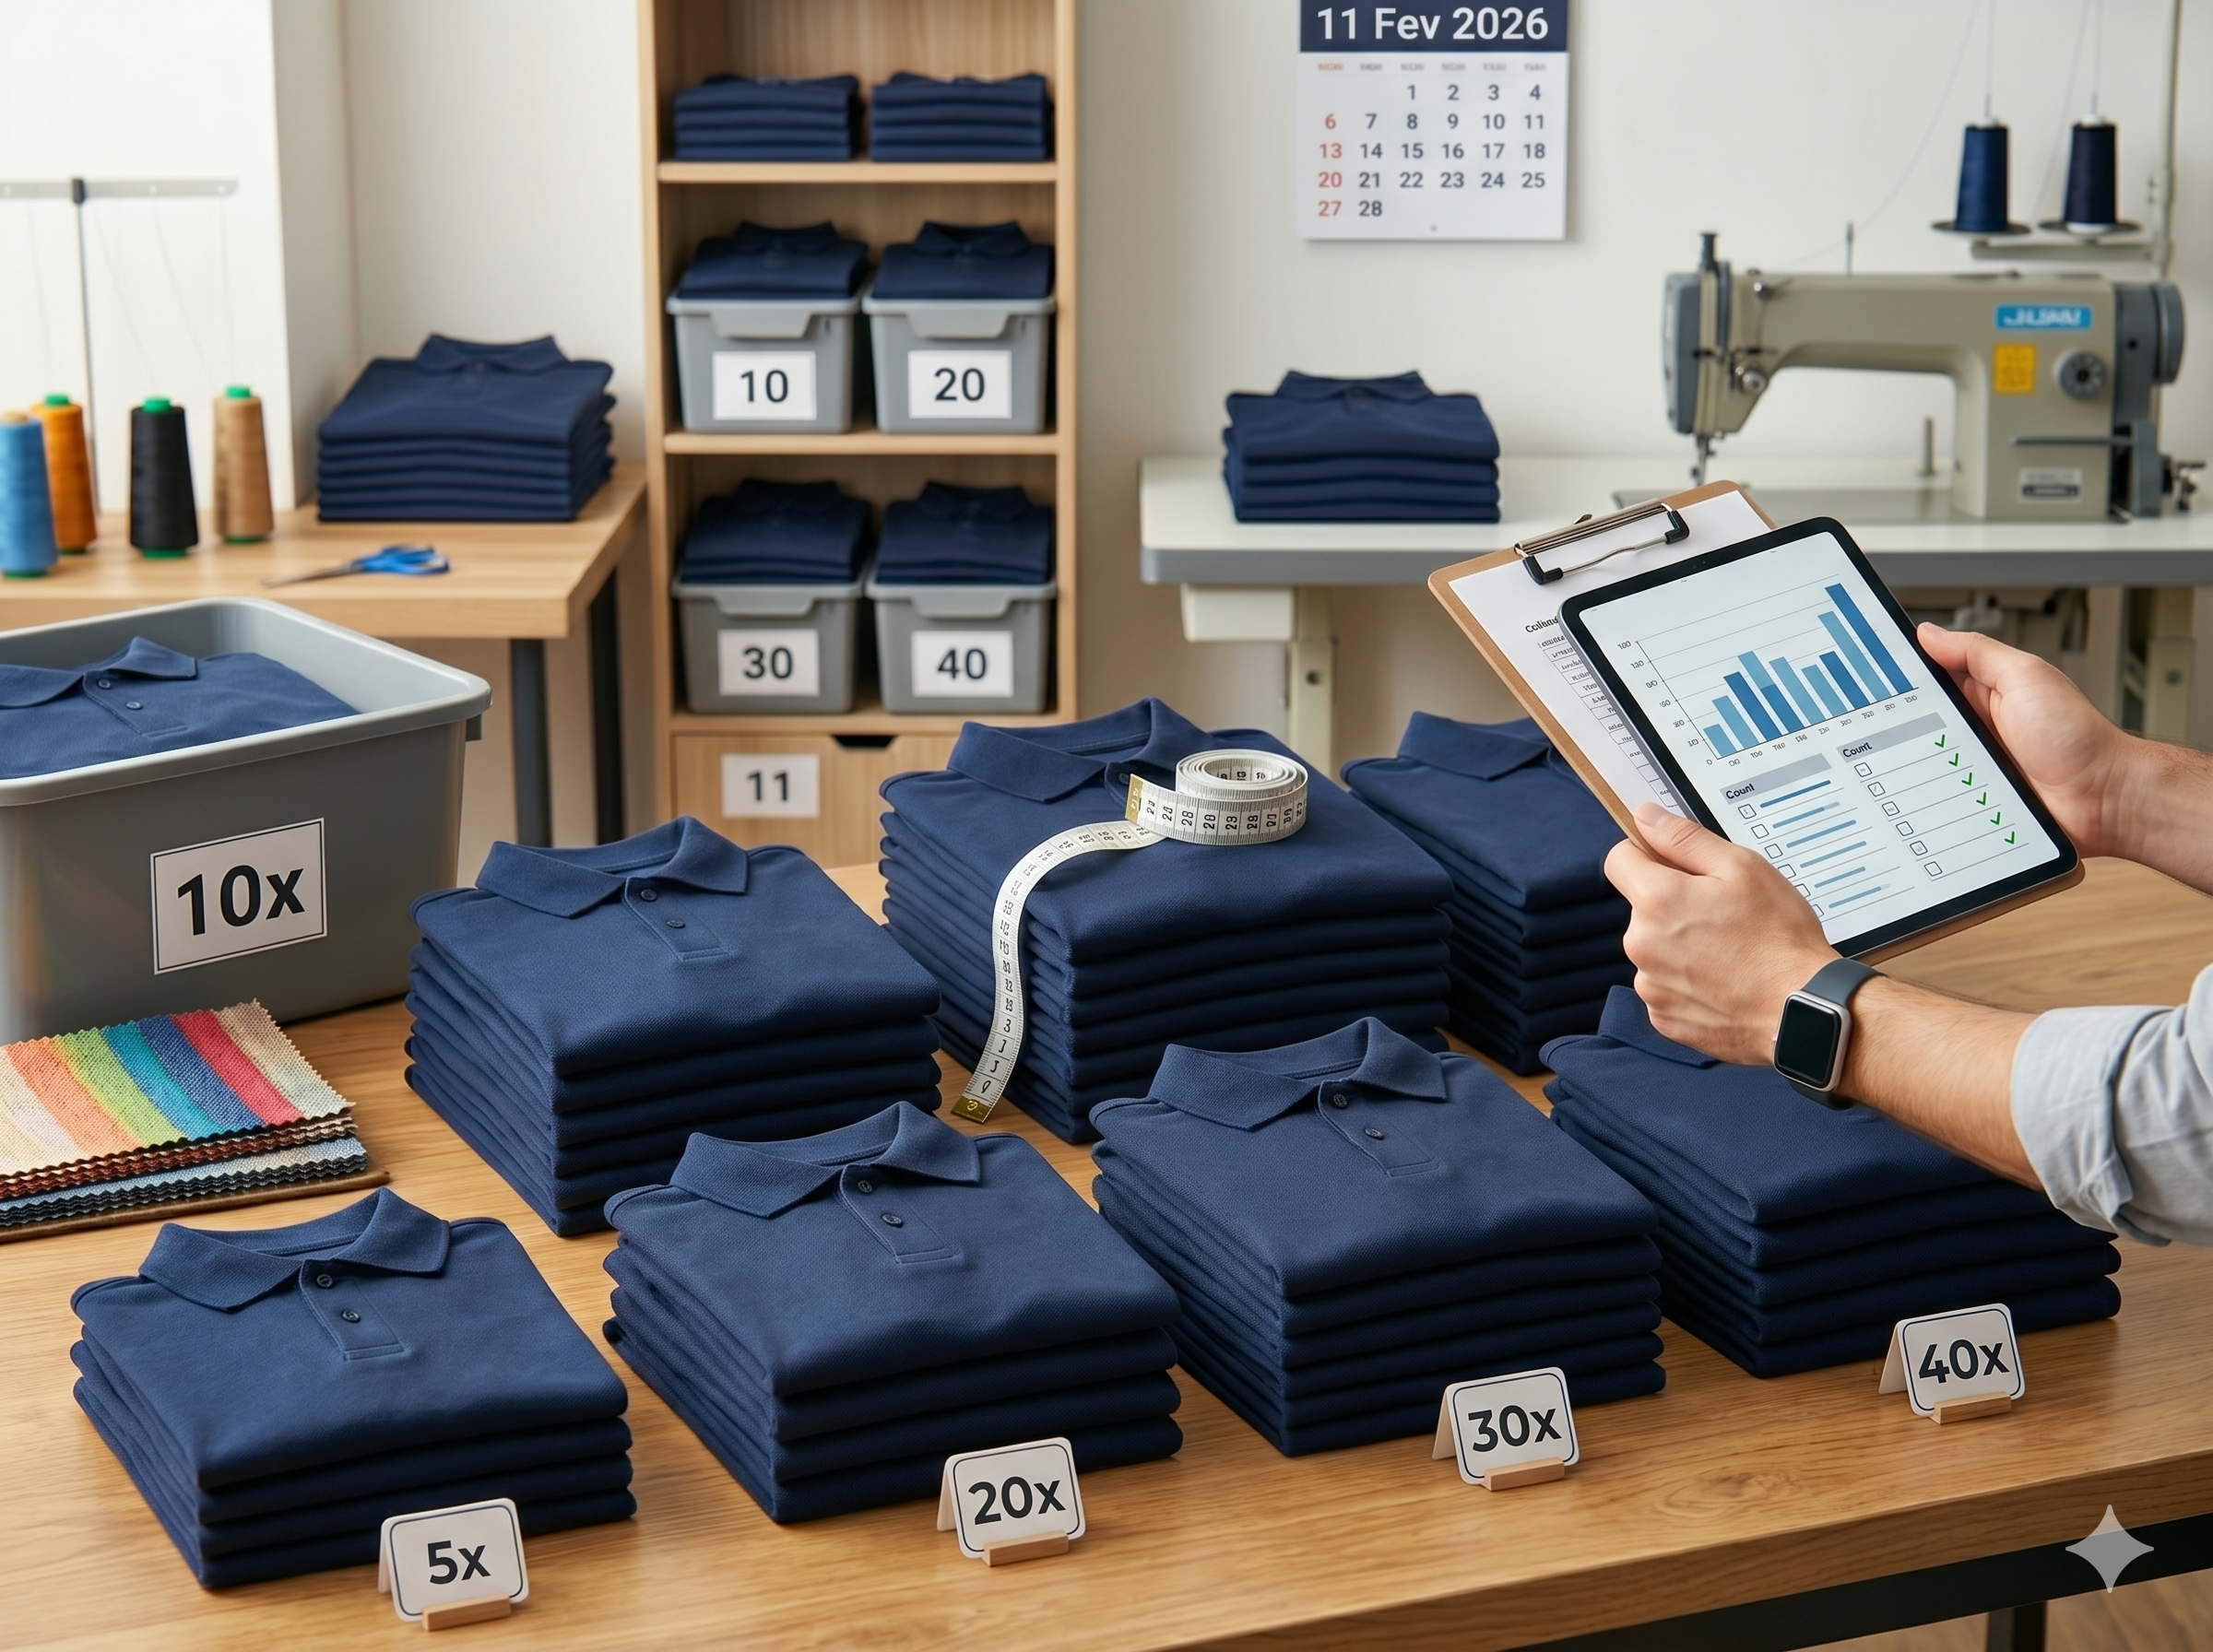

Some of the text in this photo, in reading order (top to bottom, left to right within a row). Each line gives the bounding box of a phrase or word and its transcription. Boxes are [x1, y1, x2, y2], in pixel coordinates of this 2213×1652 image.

[1318, 6, 1549, 40] 11 Fev 2026
[1407, 84, 1542, 101] 1 2 3 4
[1324, 112, 1544, 130] 6 7 8 9 10 11
[1319, 142, 1545, 159] 13 14 15 16 17 18
[1318, 171, 1546, 188] 20 21 22 23 24 25
[1318, 200, 1383, 217] 27 28
[740, 369, 788, 404] 10
[934, 367, 986, 402] 20
[742, 645, 794, 680] 30
[937, 647, 988, 681] 40
[747, 771, 788, 802] 11
[177, 864, 306, 937] 10x
[1918, 1338, 2010, 1384] 40x
[1467, 1404, 1563, 1453] 30x
[967, 1476, 1067, 1526] 20x
[427, 1540, 491, 1585] 5x
